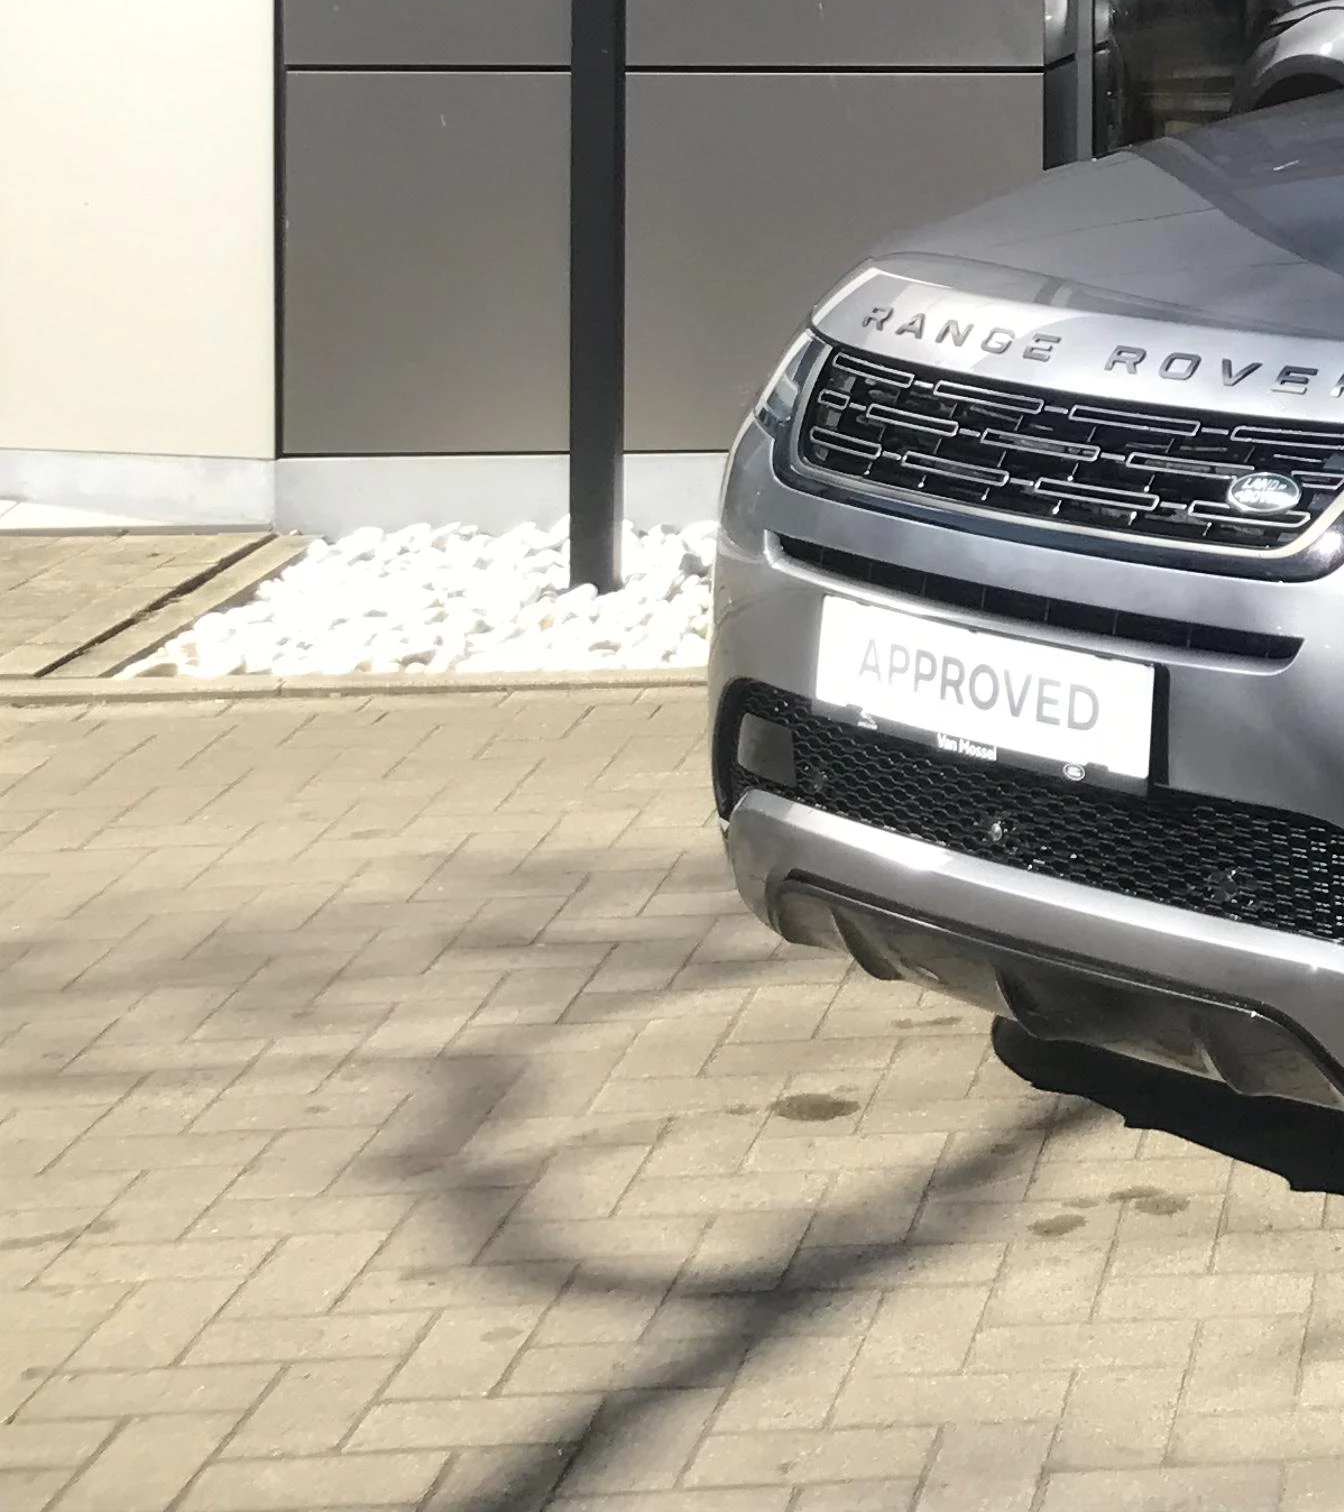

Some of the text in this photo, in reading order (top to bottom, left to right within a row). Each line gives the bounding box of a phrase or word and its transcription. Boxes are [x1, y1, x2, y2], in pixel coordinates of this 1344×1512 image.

[861, 305, 1062, 363] RANGE
[1241, 477, 1280, 491] LAND
[859, 638, 1100, 732] APPROVED
[937, 733, 997, 761] Van Mossel
